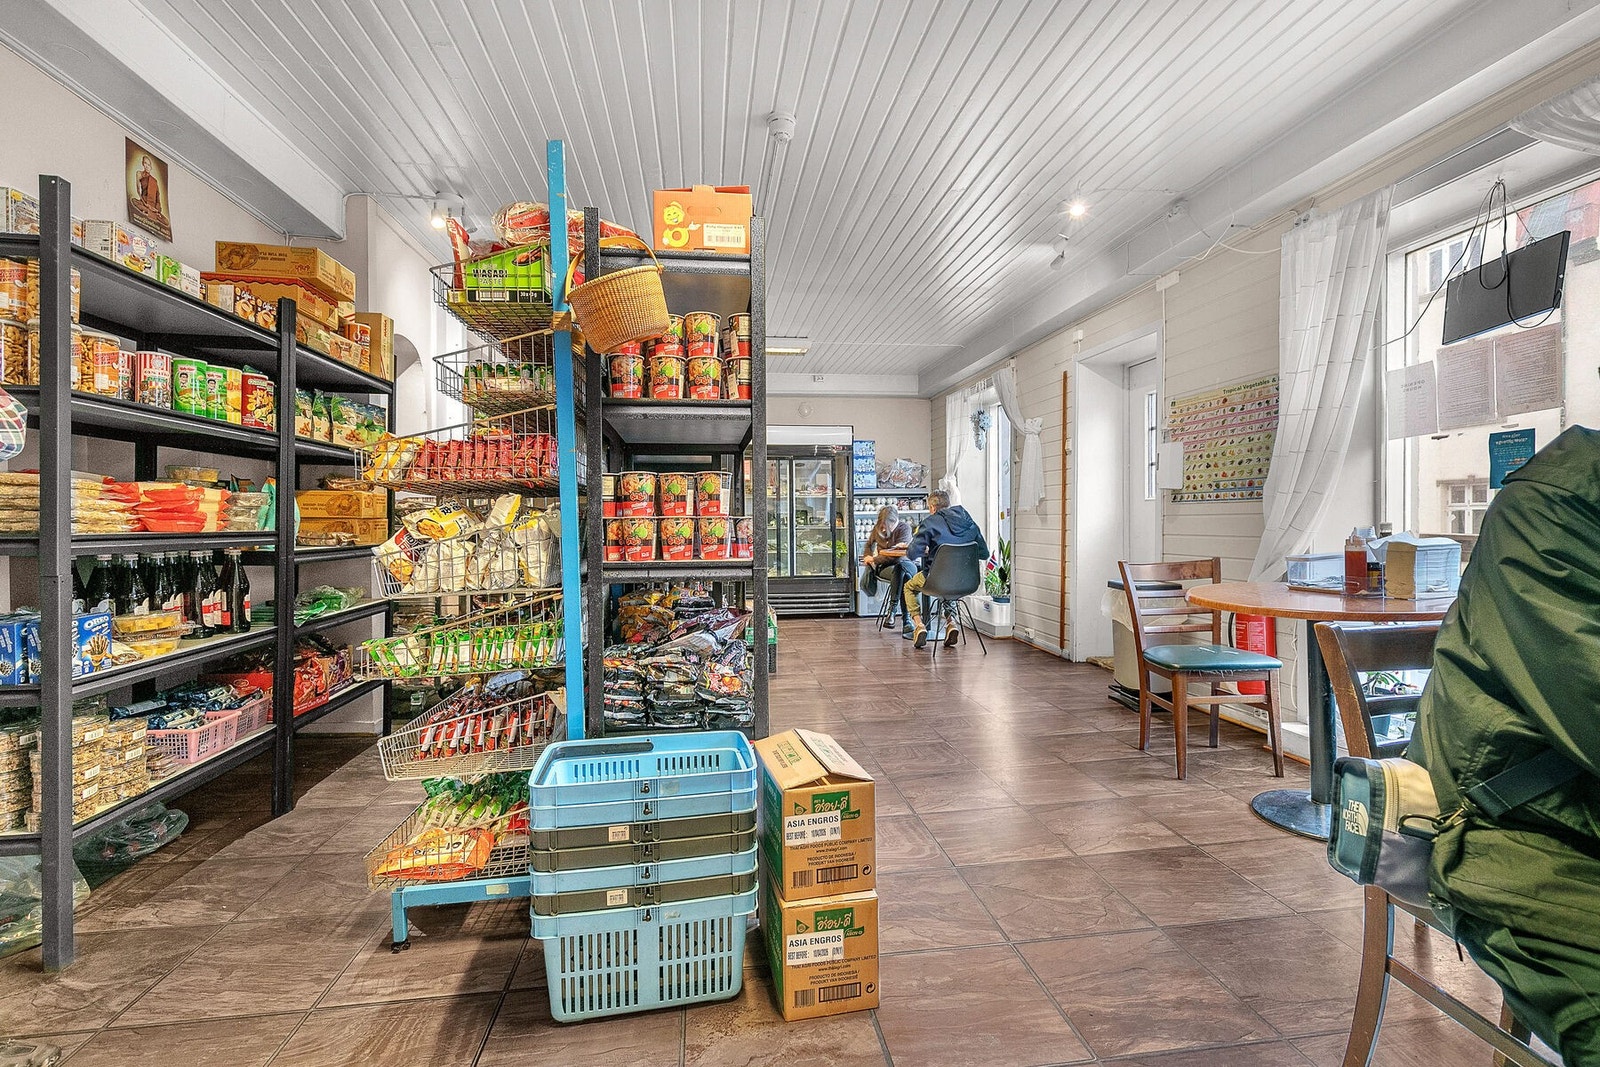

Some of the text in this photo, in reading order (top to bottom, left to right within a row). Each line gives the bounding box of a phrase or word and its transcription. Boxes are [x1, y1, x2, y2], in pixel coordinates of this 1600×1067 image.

[472, 268, 508, 278] WASABI
[1223, 385, 1243, 394] Tropical
[1243, 379, 1270, 389] Vegetables
[1348, 799, 1360, 812] THE
[786, 814, 839, 828] ASIA ENGROS
[1342, 808, 1359, 822] NORTH
[1345, 820, 1360, 834] FACE
[788, 934, 842, 948] ASIA ENGROS
